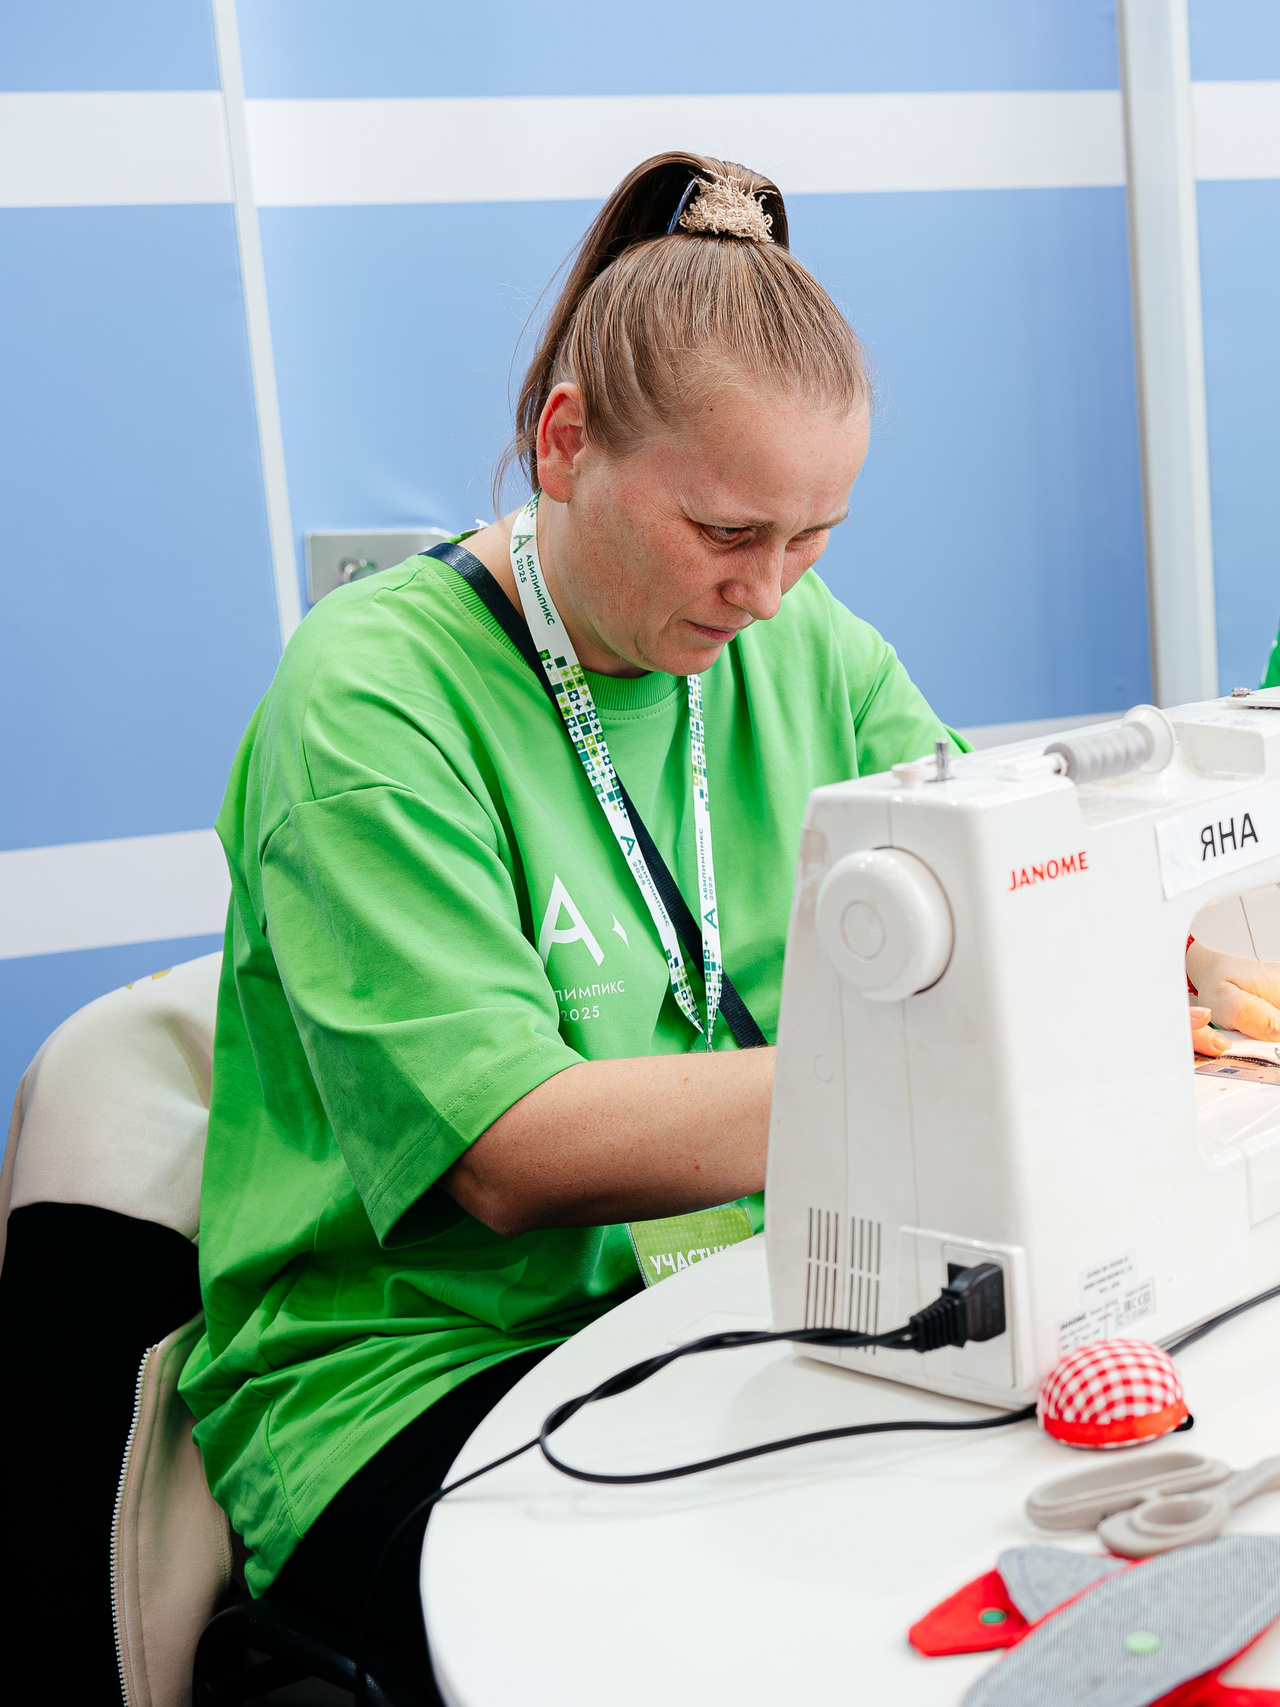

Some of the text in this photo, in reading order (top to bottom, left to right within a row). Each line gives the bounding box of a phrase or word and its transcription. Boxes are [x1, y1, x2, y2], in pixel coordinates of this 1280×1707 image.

[516, 558, 528, 584] 2025
[526, 554, 556, 626] АБИЛИМПИКС
[1200, 812, 1259, 862] ЯНА
[632, 861, 646, 886] 2025
[1008, 851, 1090, 892] JANOME
[553, 980, 625, 1002] ЛИМПИКС
[560, 1005, 600, 1022] 2025
[649, 1244, 733, 1275] УЧАСТ
